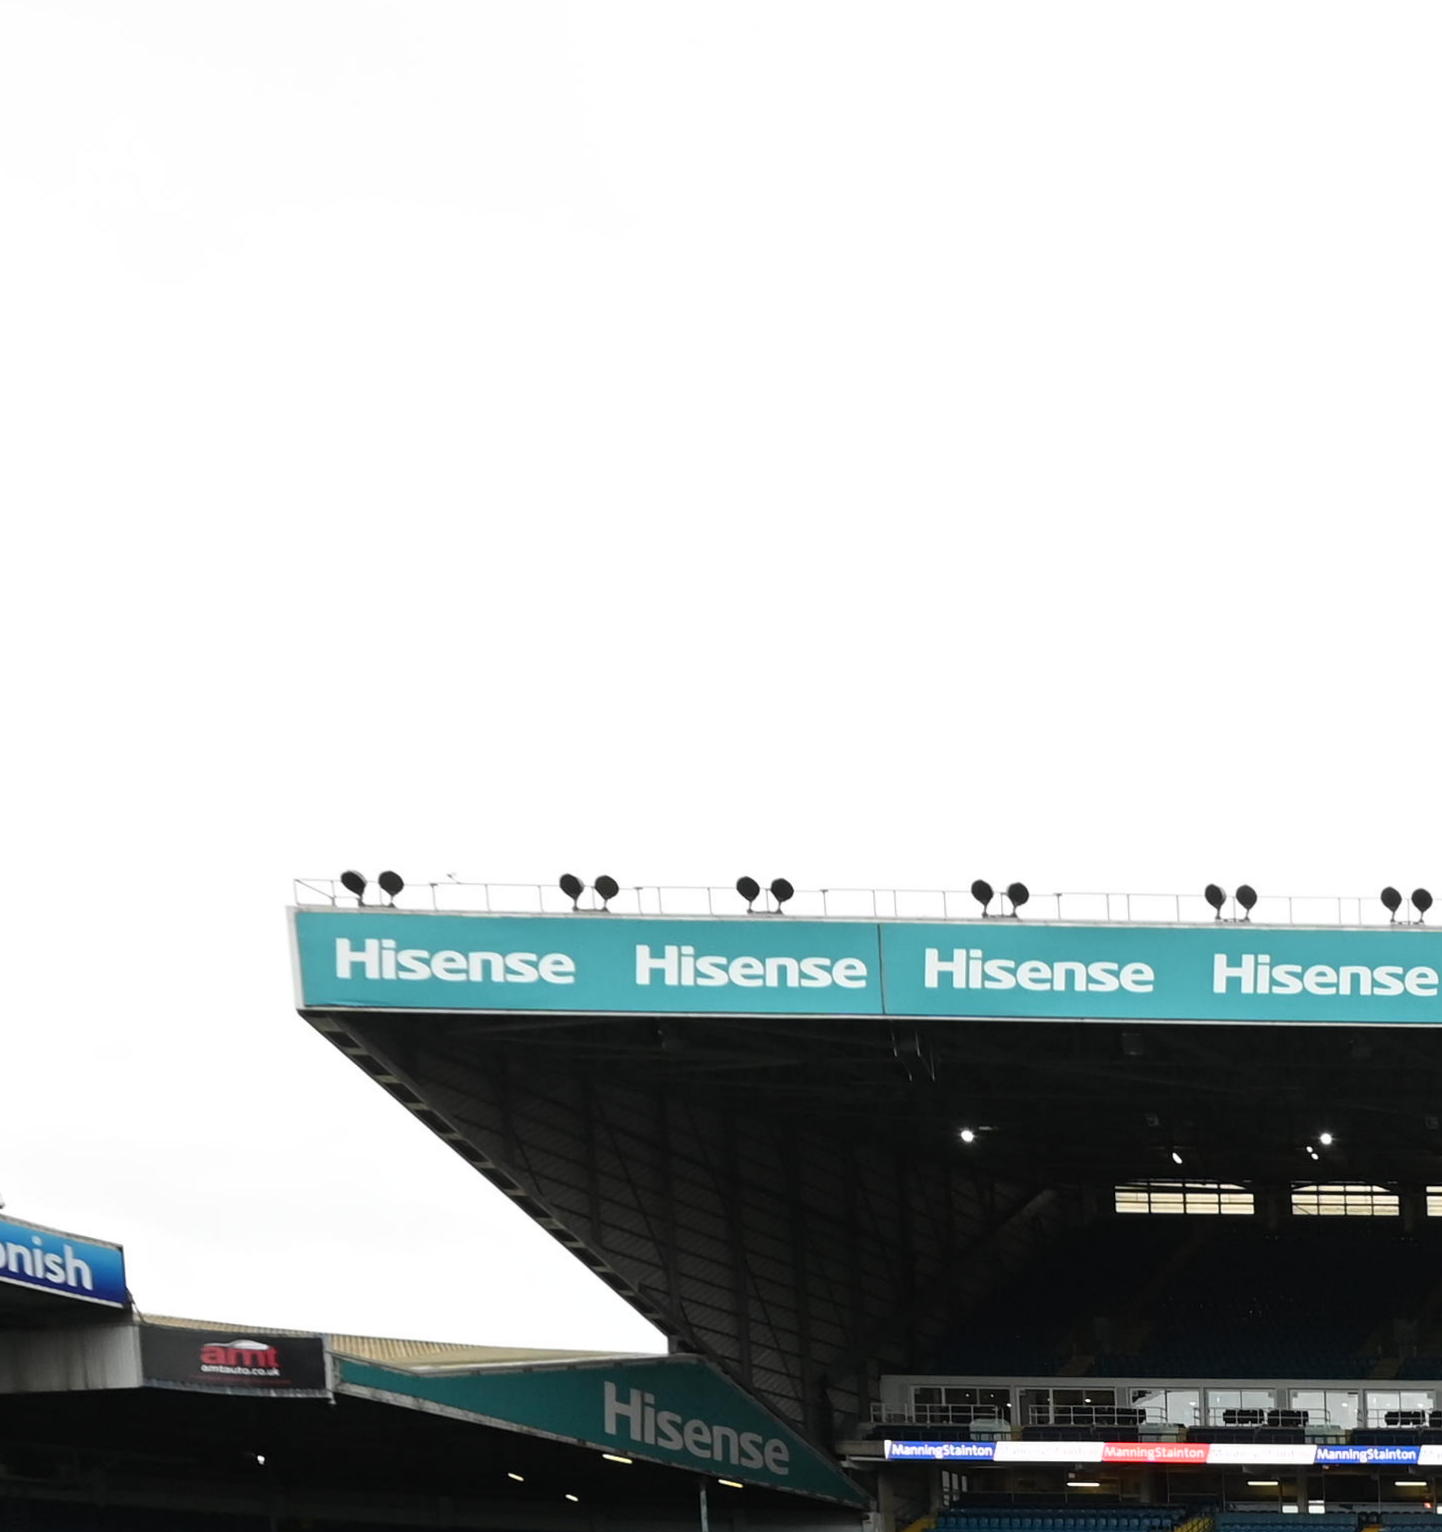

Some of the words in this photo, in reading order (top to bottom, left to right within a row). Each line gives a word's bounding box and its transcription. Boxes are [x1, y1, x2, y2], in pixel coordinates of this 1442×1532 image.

[335, 937, 575, 985] Hisense
[635, 944, 867, 989] Hisense
[924, 947, 1154, 992] Hisense
[1212, 953, 1439, 997] Hisense
[200, 1363, 281, 1376] amtauto.co.uk
[201, 1344, 281, 1368] amt
[603, 1380, 790, 1475] Hisense
